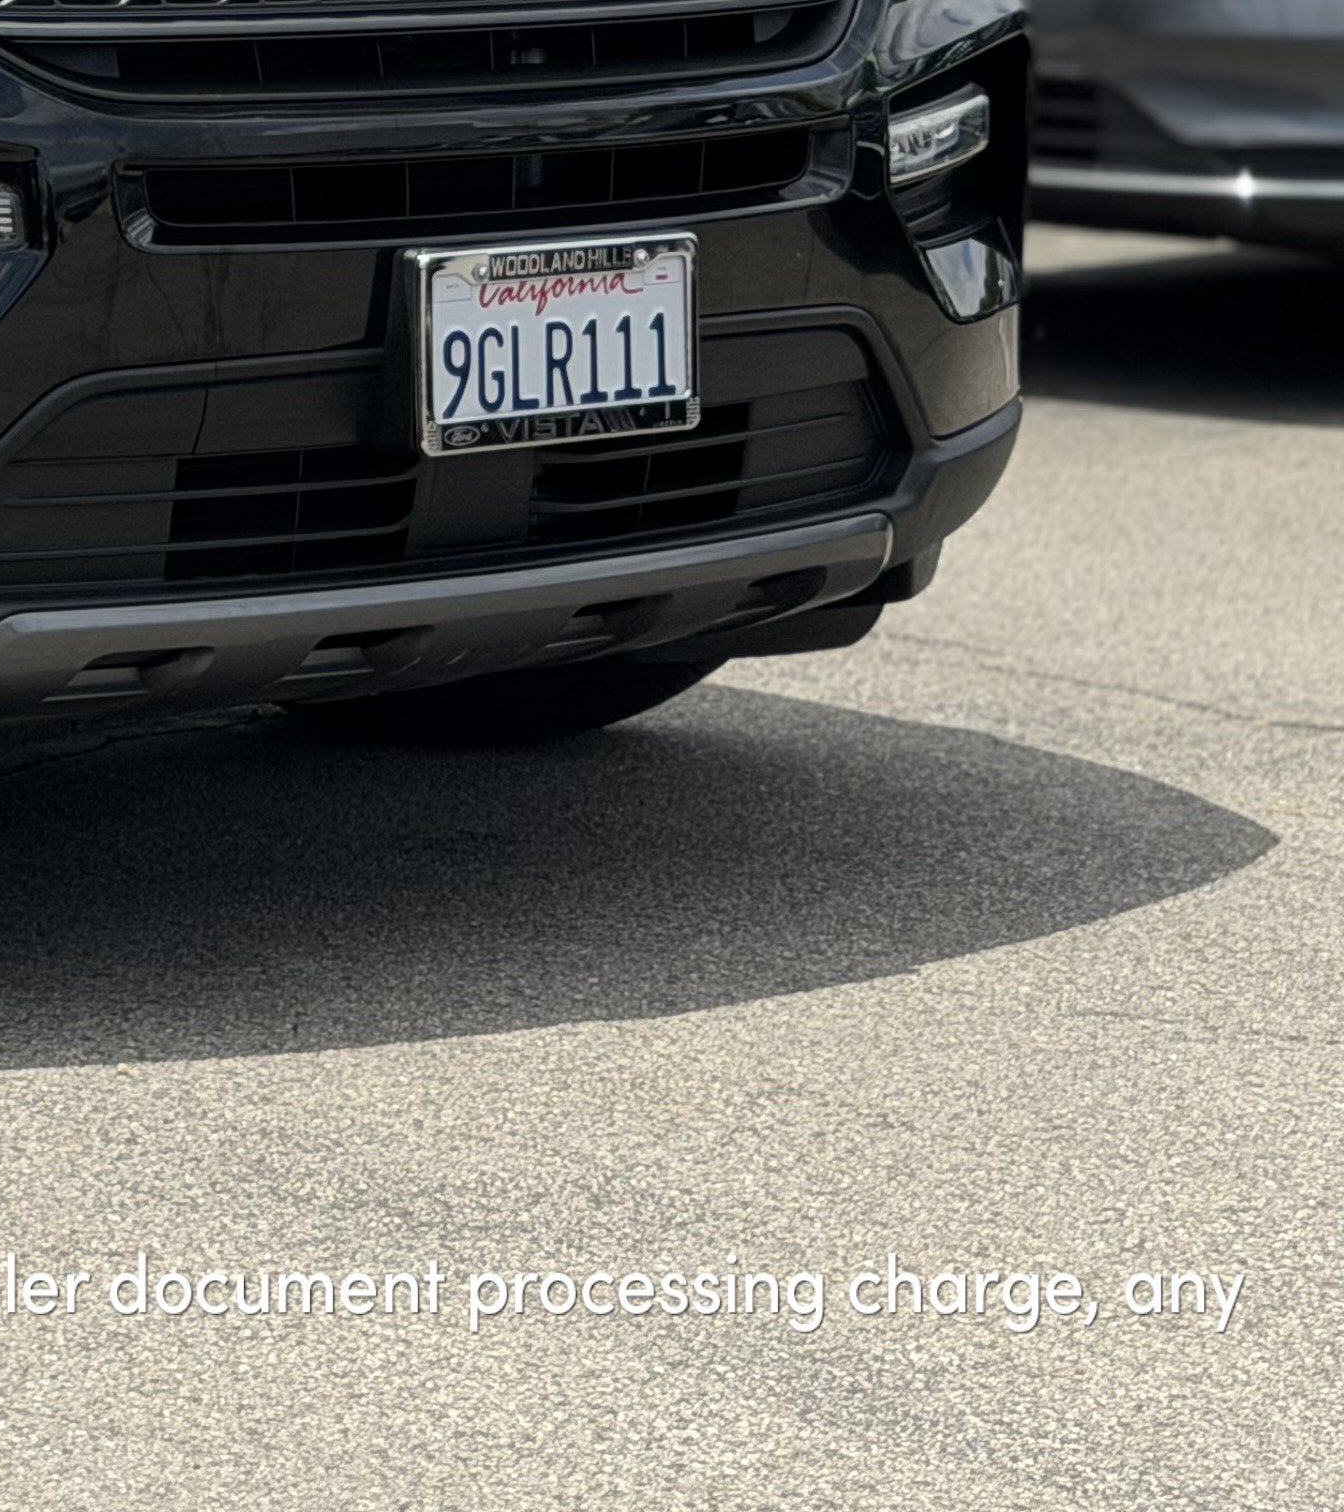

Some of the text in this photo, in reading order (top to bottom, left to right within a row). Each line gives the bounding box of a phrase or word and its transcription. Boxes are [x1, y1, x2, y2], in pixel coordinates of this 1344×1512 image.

[490, 249, 586, 278] WOODLAND
[478, 272, 645, 317] California
[442, 312, 677, 420] 9GLR111
[496, 410, 604, 443] VISTA
